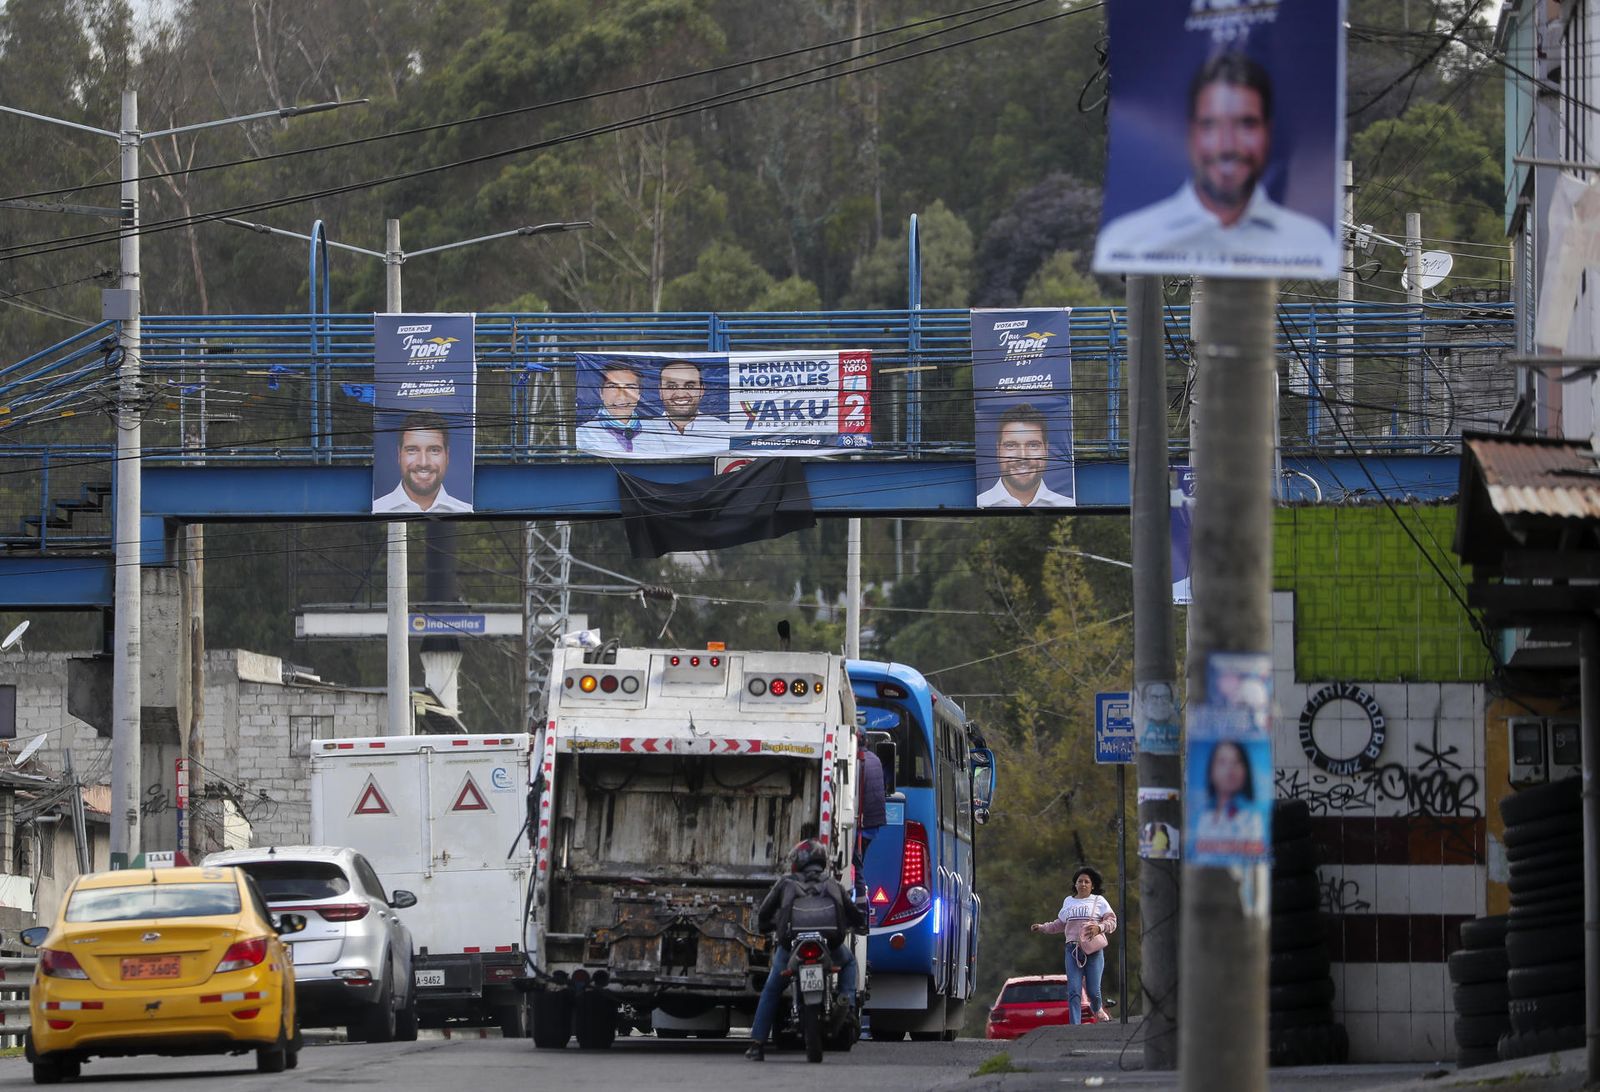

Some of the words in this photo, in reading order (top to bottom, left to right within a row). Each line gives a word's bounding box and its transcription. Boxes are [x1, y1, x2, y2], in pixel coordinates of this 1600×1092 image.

[410, 343, 452, 358] TOPIC
[1007, 337, 1049, 353] TOPIC
[739, 360, 831, 374] FERNANDO
[843, 363, 868, 373] TODO
[739, 373, 830, 387] MORALES
[999, 377, 1015, 385] DEL
[1016, 374, 1044, 383] MIEDO
[1044, 373, 1052, 381] A
[397, 389, 408, 397] LA
[408, 386, 456, 396] ESPERANZA
[844, 393, 866, 420] 2
[740, 399, 830, 430] YAKU
[757, 420, 829, 428] PRESIDENTE
[1328, 758, 1361, 775] RUIZ
[148, 853, 173, 863] TAXI
